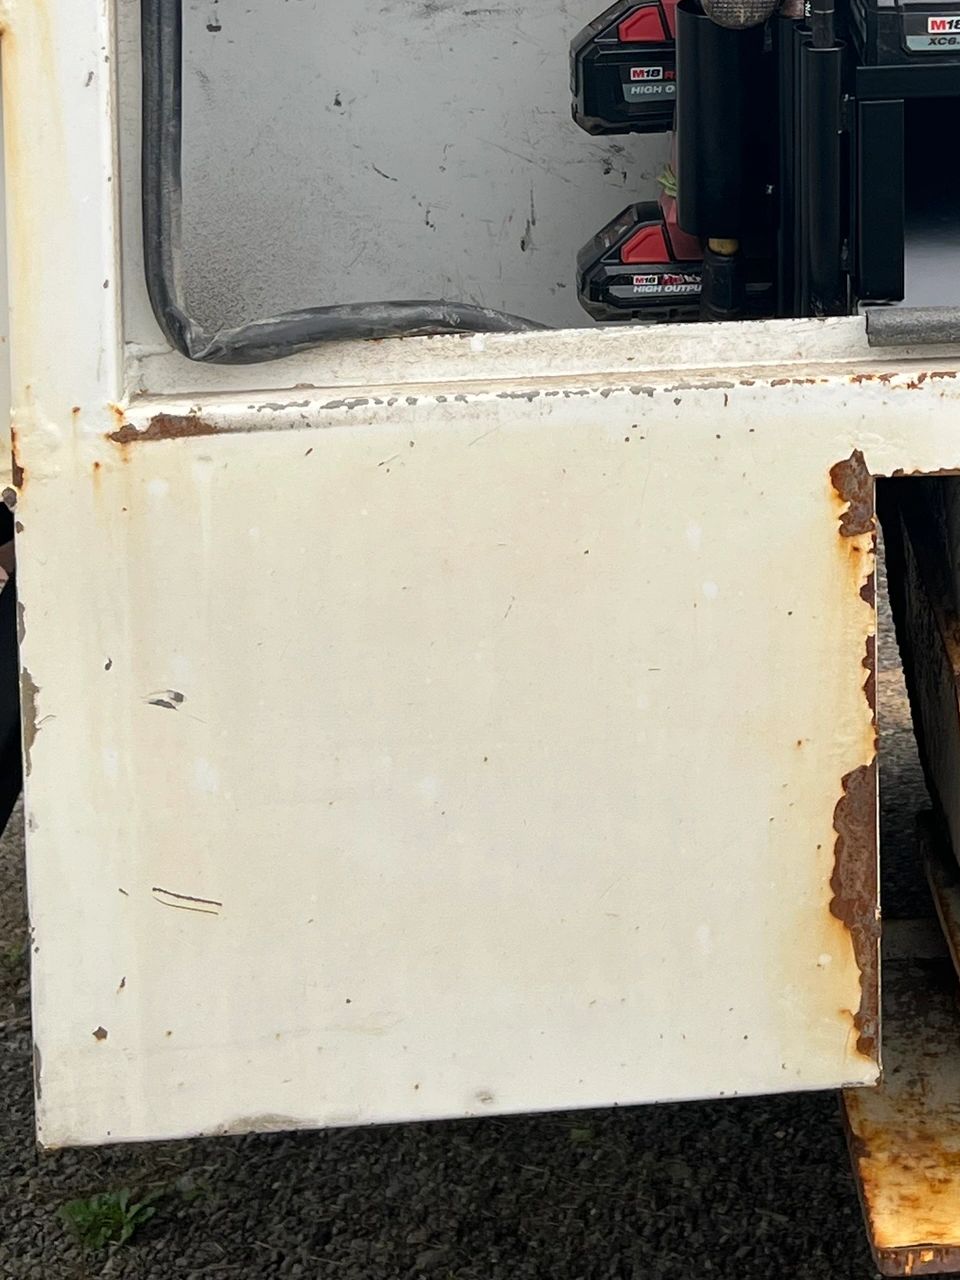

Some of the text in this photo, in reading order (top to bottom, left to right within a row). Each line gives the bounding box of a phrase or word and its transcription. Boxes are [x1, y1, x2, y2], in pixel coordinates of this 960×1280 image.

[632, 69, 661, 79] M18
[630, 85, 662, 95] HIGH
[633, 284, 702, 293] HIGH OUTPU
